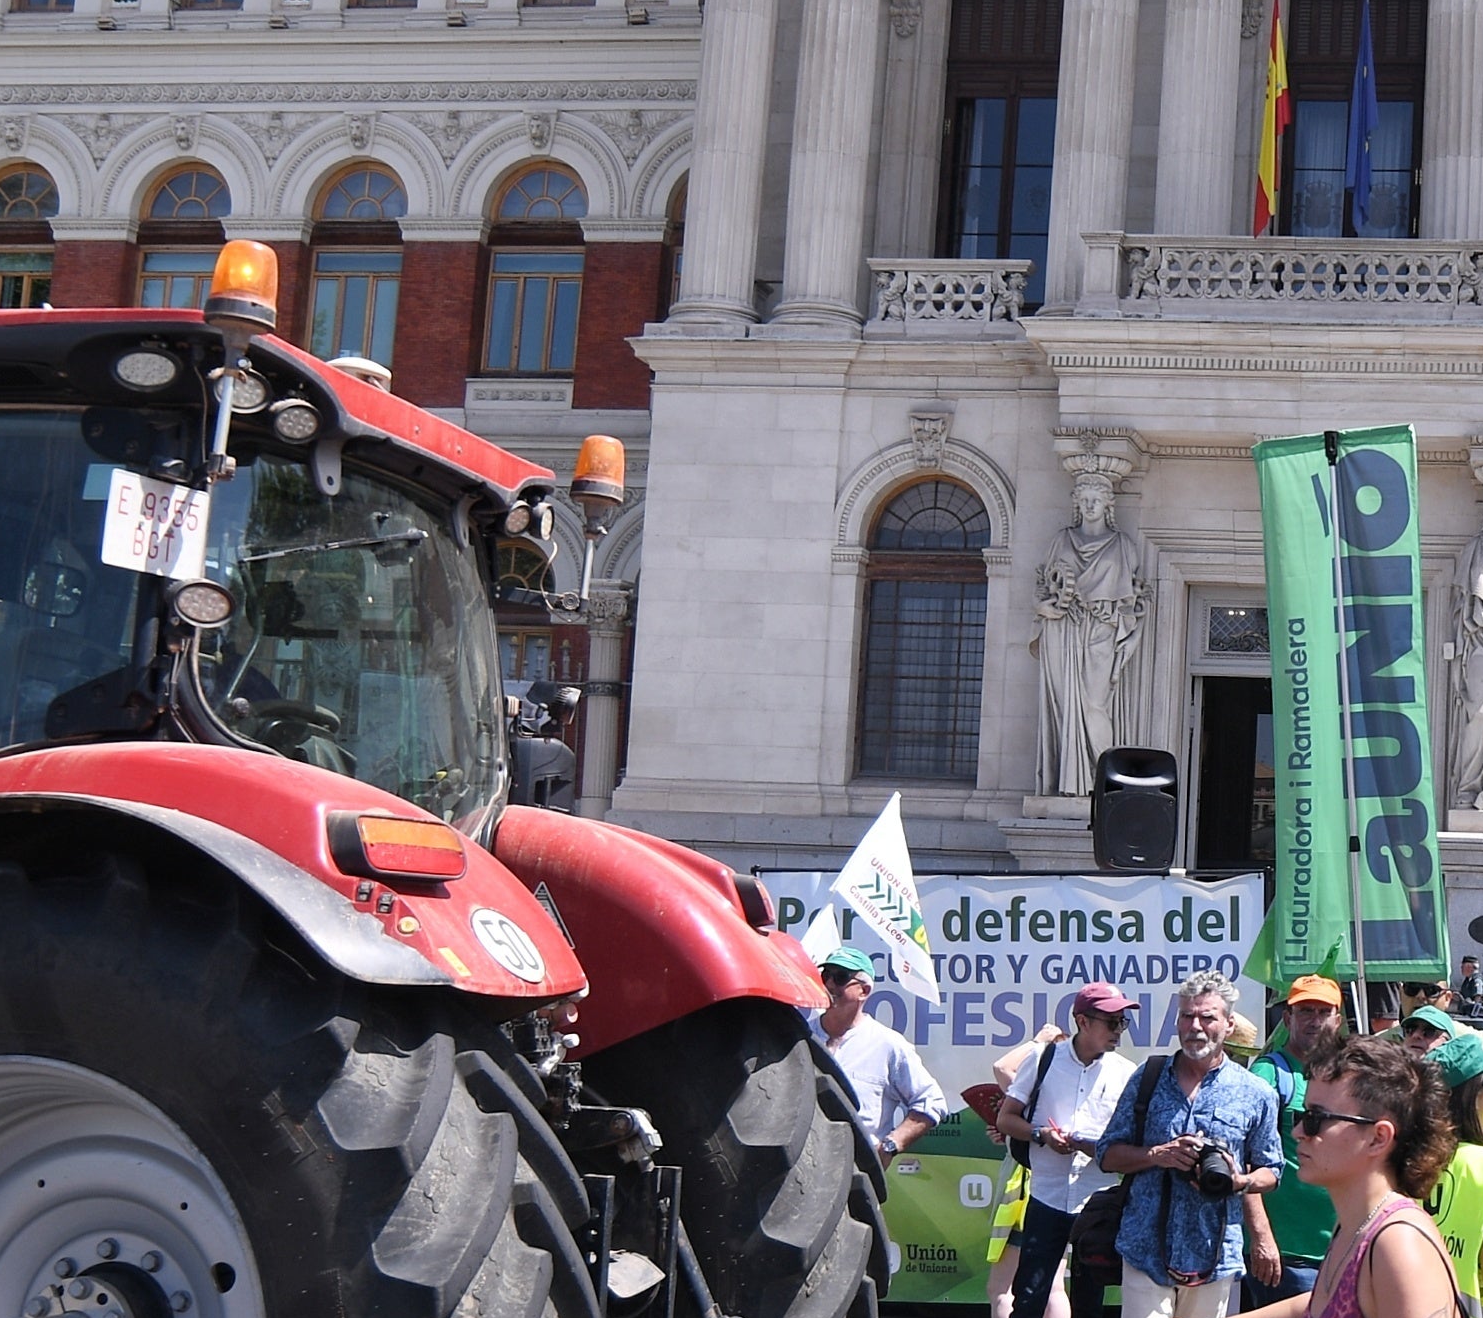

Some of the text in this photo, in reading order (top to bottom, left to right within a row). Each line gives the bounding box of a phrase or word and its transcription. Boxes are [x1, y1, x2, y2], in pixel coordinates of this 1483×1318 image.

[118, 485, 200, 532] E 9355
[133, 525, 175, 563] BGT
[1284, 617, 1312, 770] Ramadera
[1284, 797, 1313, 962] Llauradora
[942, 895, 1145, 943] defensa
[1162, 894, 1241, 943] del
[478, 918, 540, 971] 50
[1005, 953, 1029, 984] Y
[1040, 952, 1241, 985] GANADERO
[905, 1243, 958, 1261] Unión
[905, 1262, 958, 1273] de Uniones
